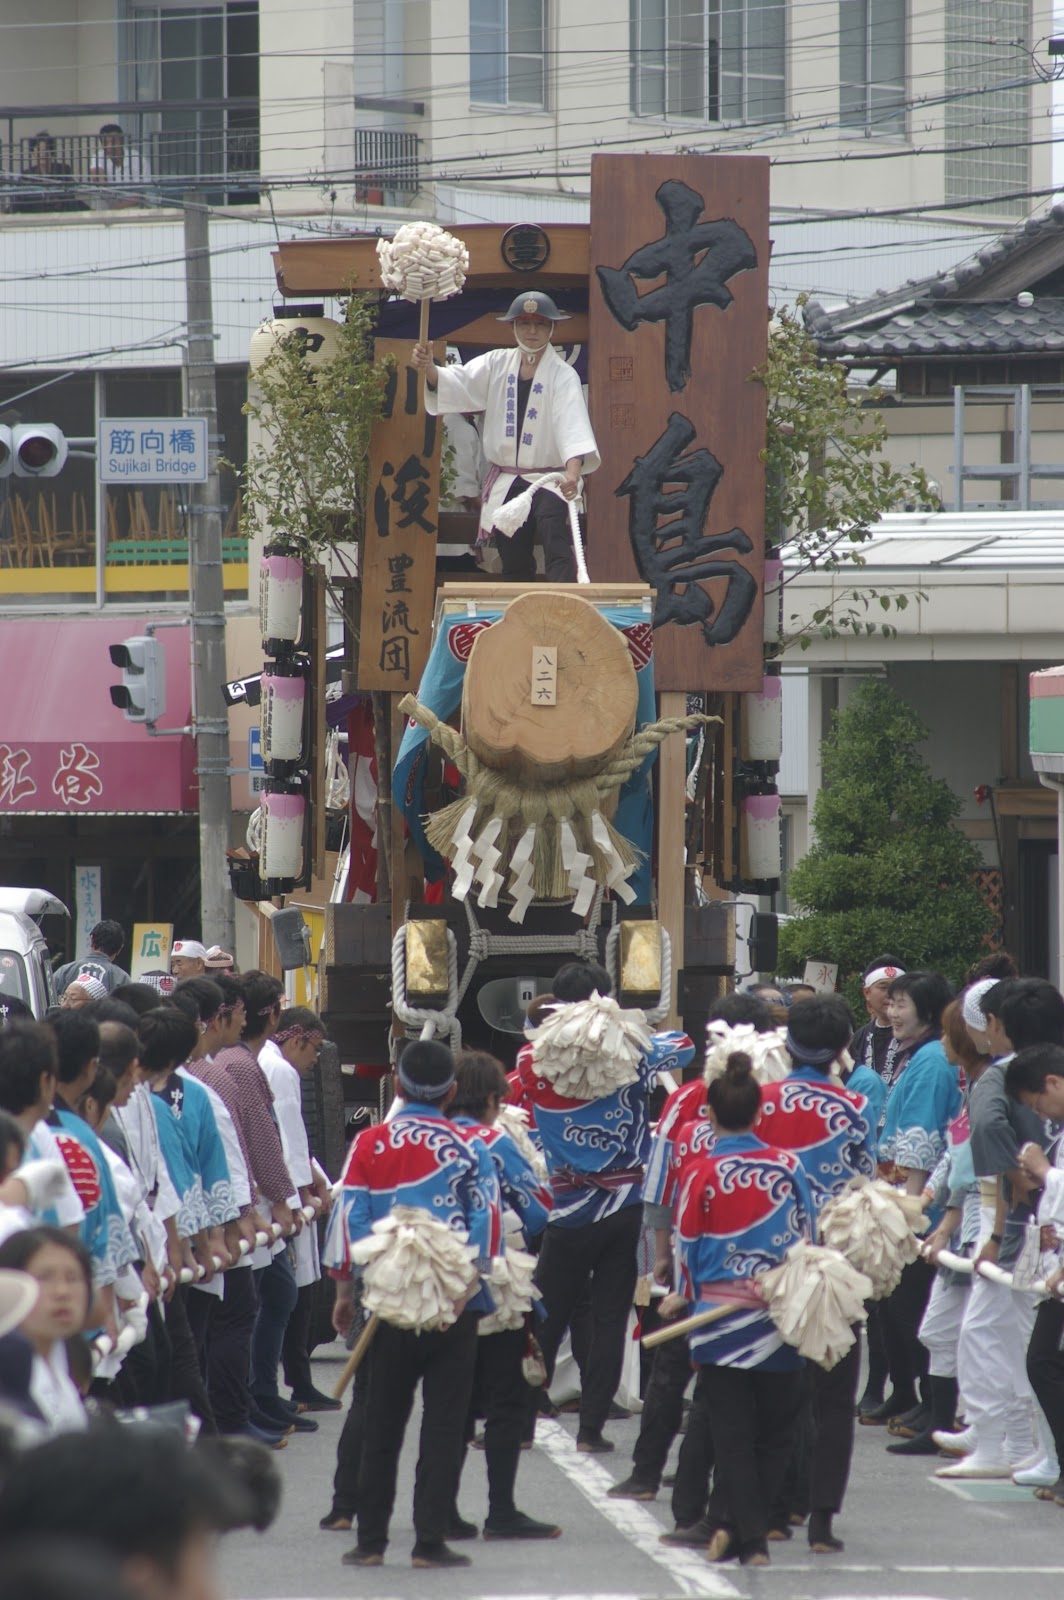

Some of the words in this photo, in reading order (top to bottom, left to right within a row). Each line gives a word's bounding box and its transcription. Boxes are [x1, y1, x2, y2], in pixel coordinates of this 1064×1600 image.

[596, 178, 757, 648] 中島
[109, 428, 196, 455] 筋向橋
[109, 459, 151, 475] Sujikai
[156, 459, 197, 475] Bridge
[536, 653, 554, 700] 八二六
[141, 930, 162, 958] 広
